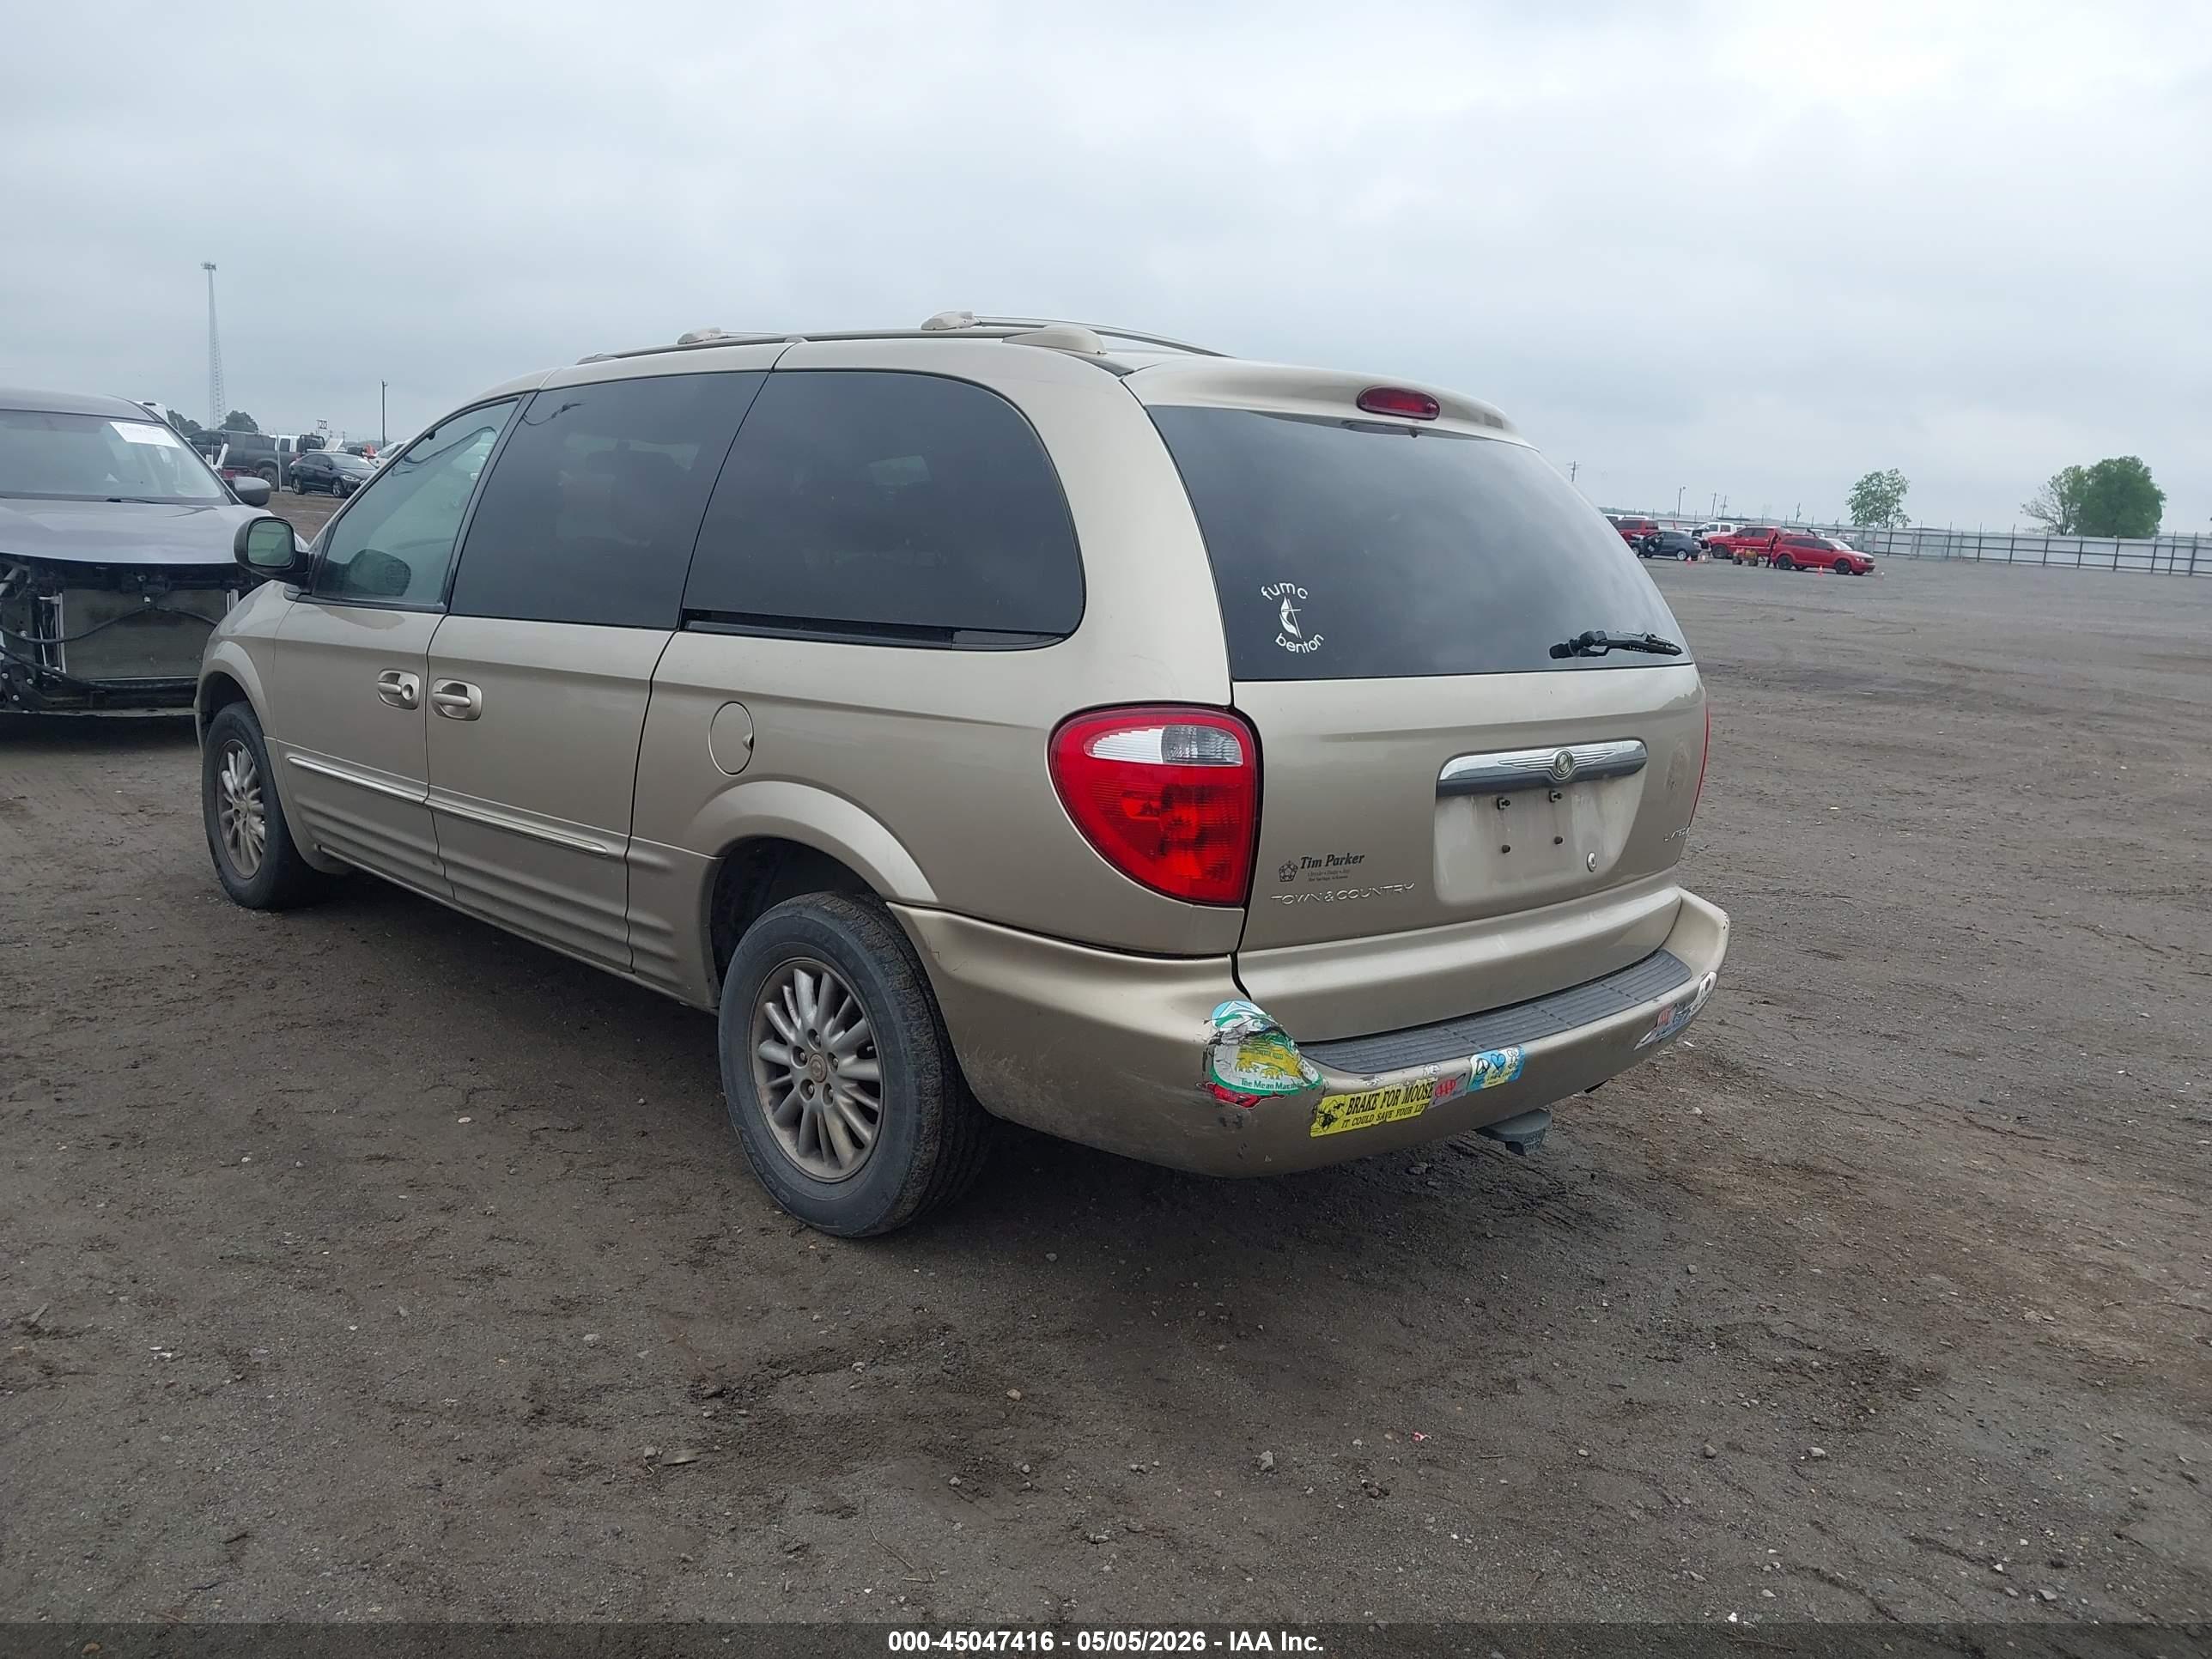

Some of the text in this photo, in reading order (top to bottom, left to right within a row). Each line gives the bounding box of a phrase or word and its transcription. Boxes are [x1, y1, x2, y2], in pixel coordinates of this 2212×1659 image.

[1261, 582, 1309, 601] fumc
[1274, 632, 1325, 653] benton
[1299, 853, 1365, 870] Tim Parker
[1271, 891, 1322, 906] TOWN
[1336, 882, 1415, 901] COUNTRY
[1254, 1080, 1274, 1090] Mean
[1345, 1081, 1437, 1116] BRAKE FOR MOOSE
[1341, 1103, 1426, 1129] IT COULD SAVE YOUR LIF
